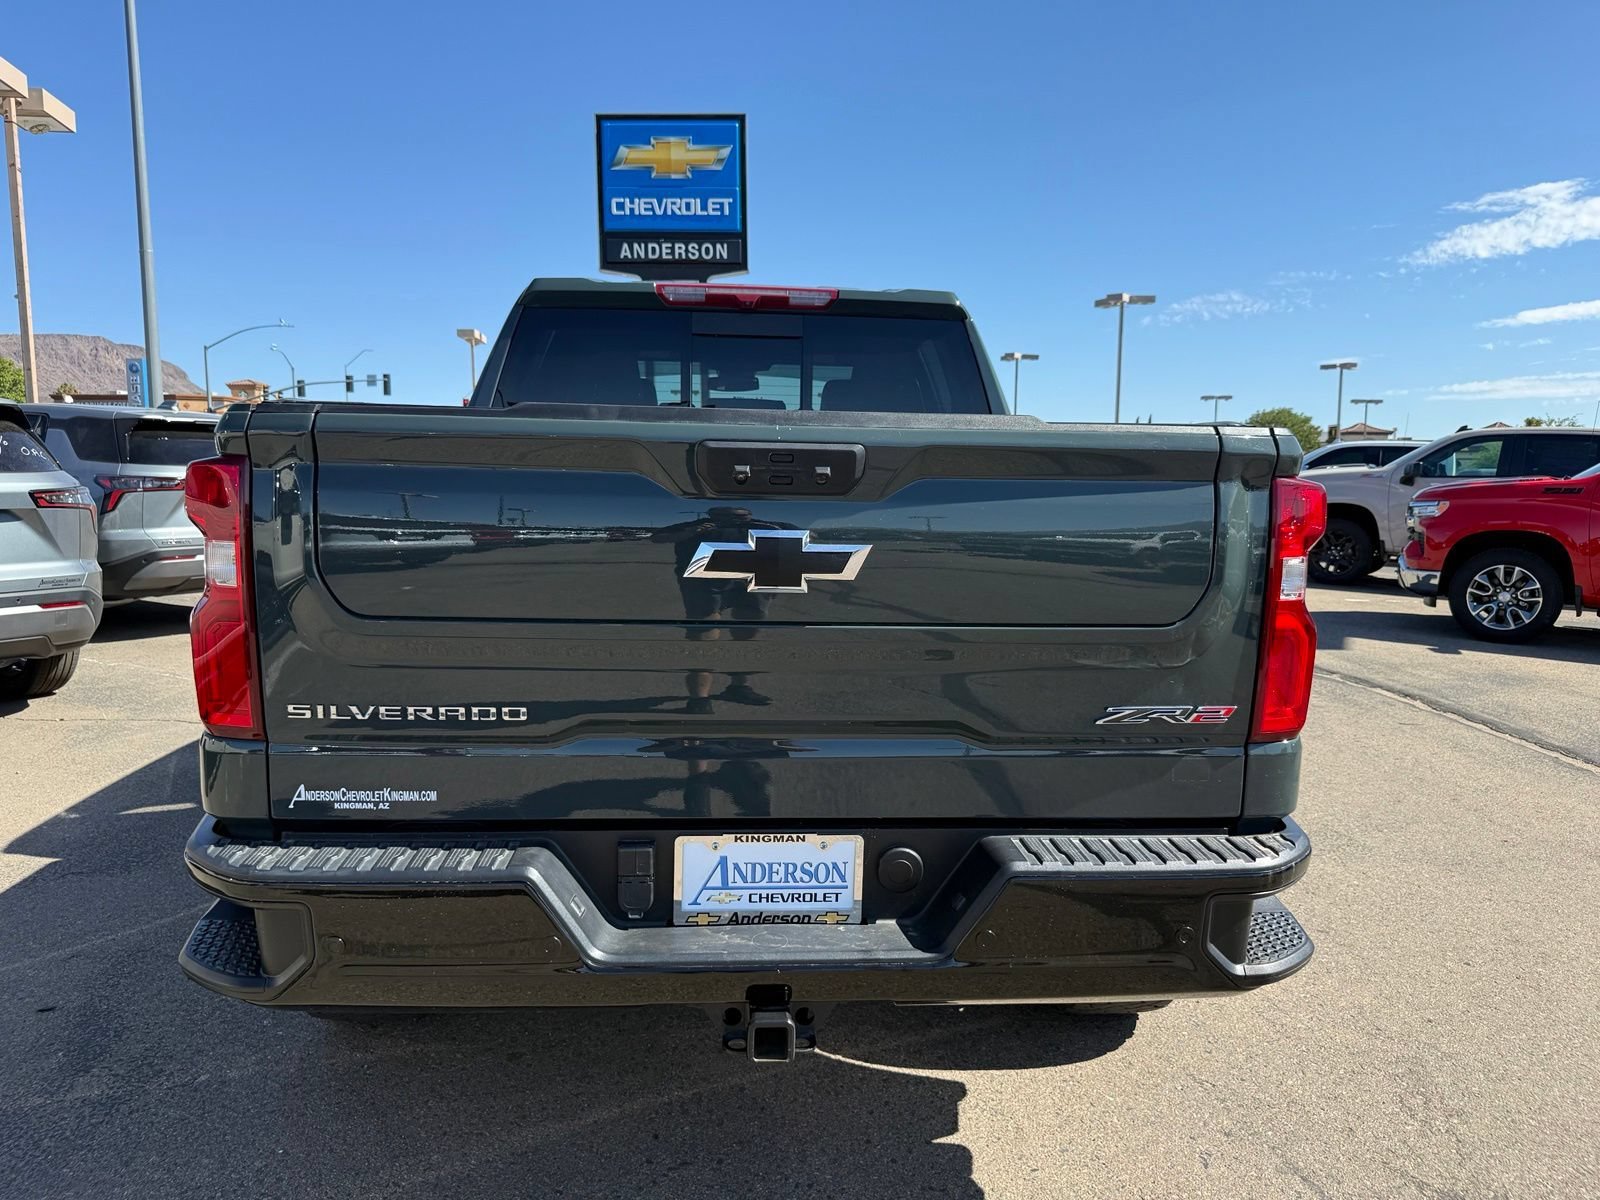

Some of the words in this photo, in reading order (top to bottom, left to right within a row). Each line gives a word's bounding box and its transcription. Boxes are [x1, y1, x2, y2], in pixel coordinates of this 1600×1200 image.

[610, 197, 733, 216] CHEVROLET
[619, 242, 728, 260] ANDERSON
[286, 703, 528, 721] SILVERADO
[1093, 705, 1238, 725] ZR2
[334, 802, 377, 810] KINGMAN,
[378, 802, 390, 810] AZ
[733, 834, 807, 843] KINGMAN
[688, 855, 849, 906] ANDERSON
[748, 892, 842, 904] CHEVROLET
[727, 911, 812, 925] Anderson
